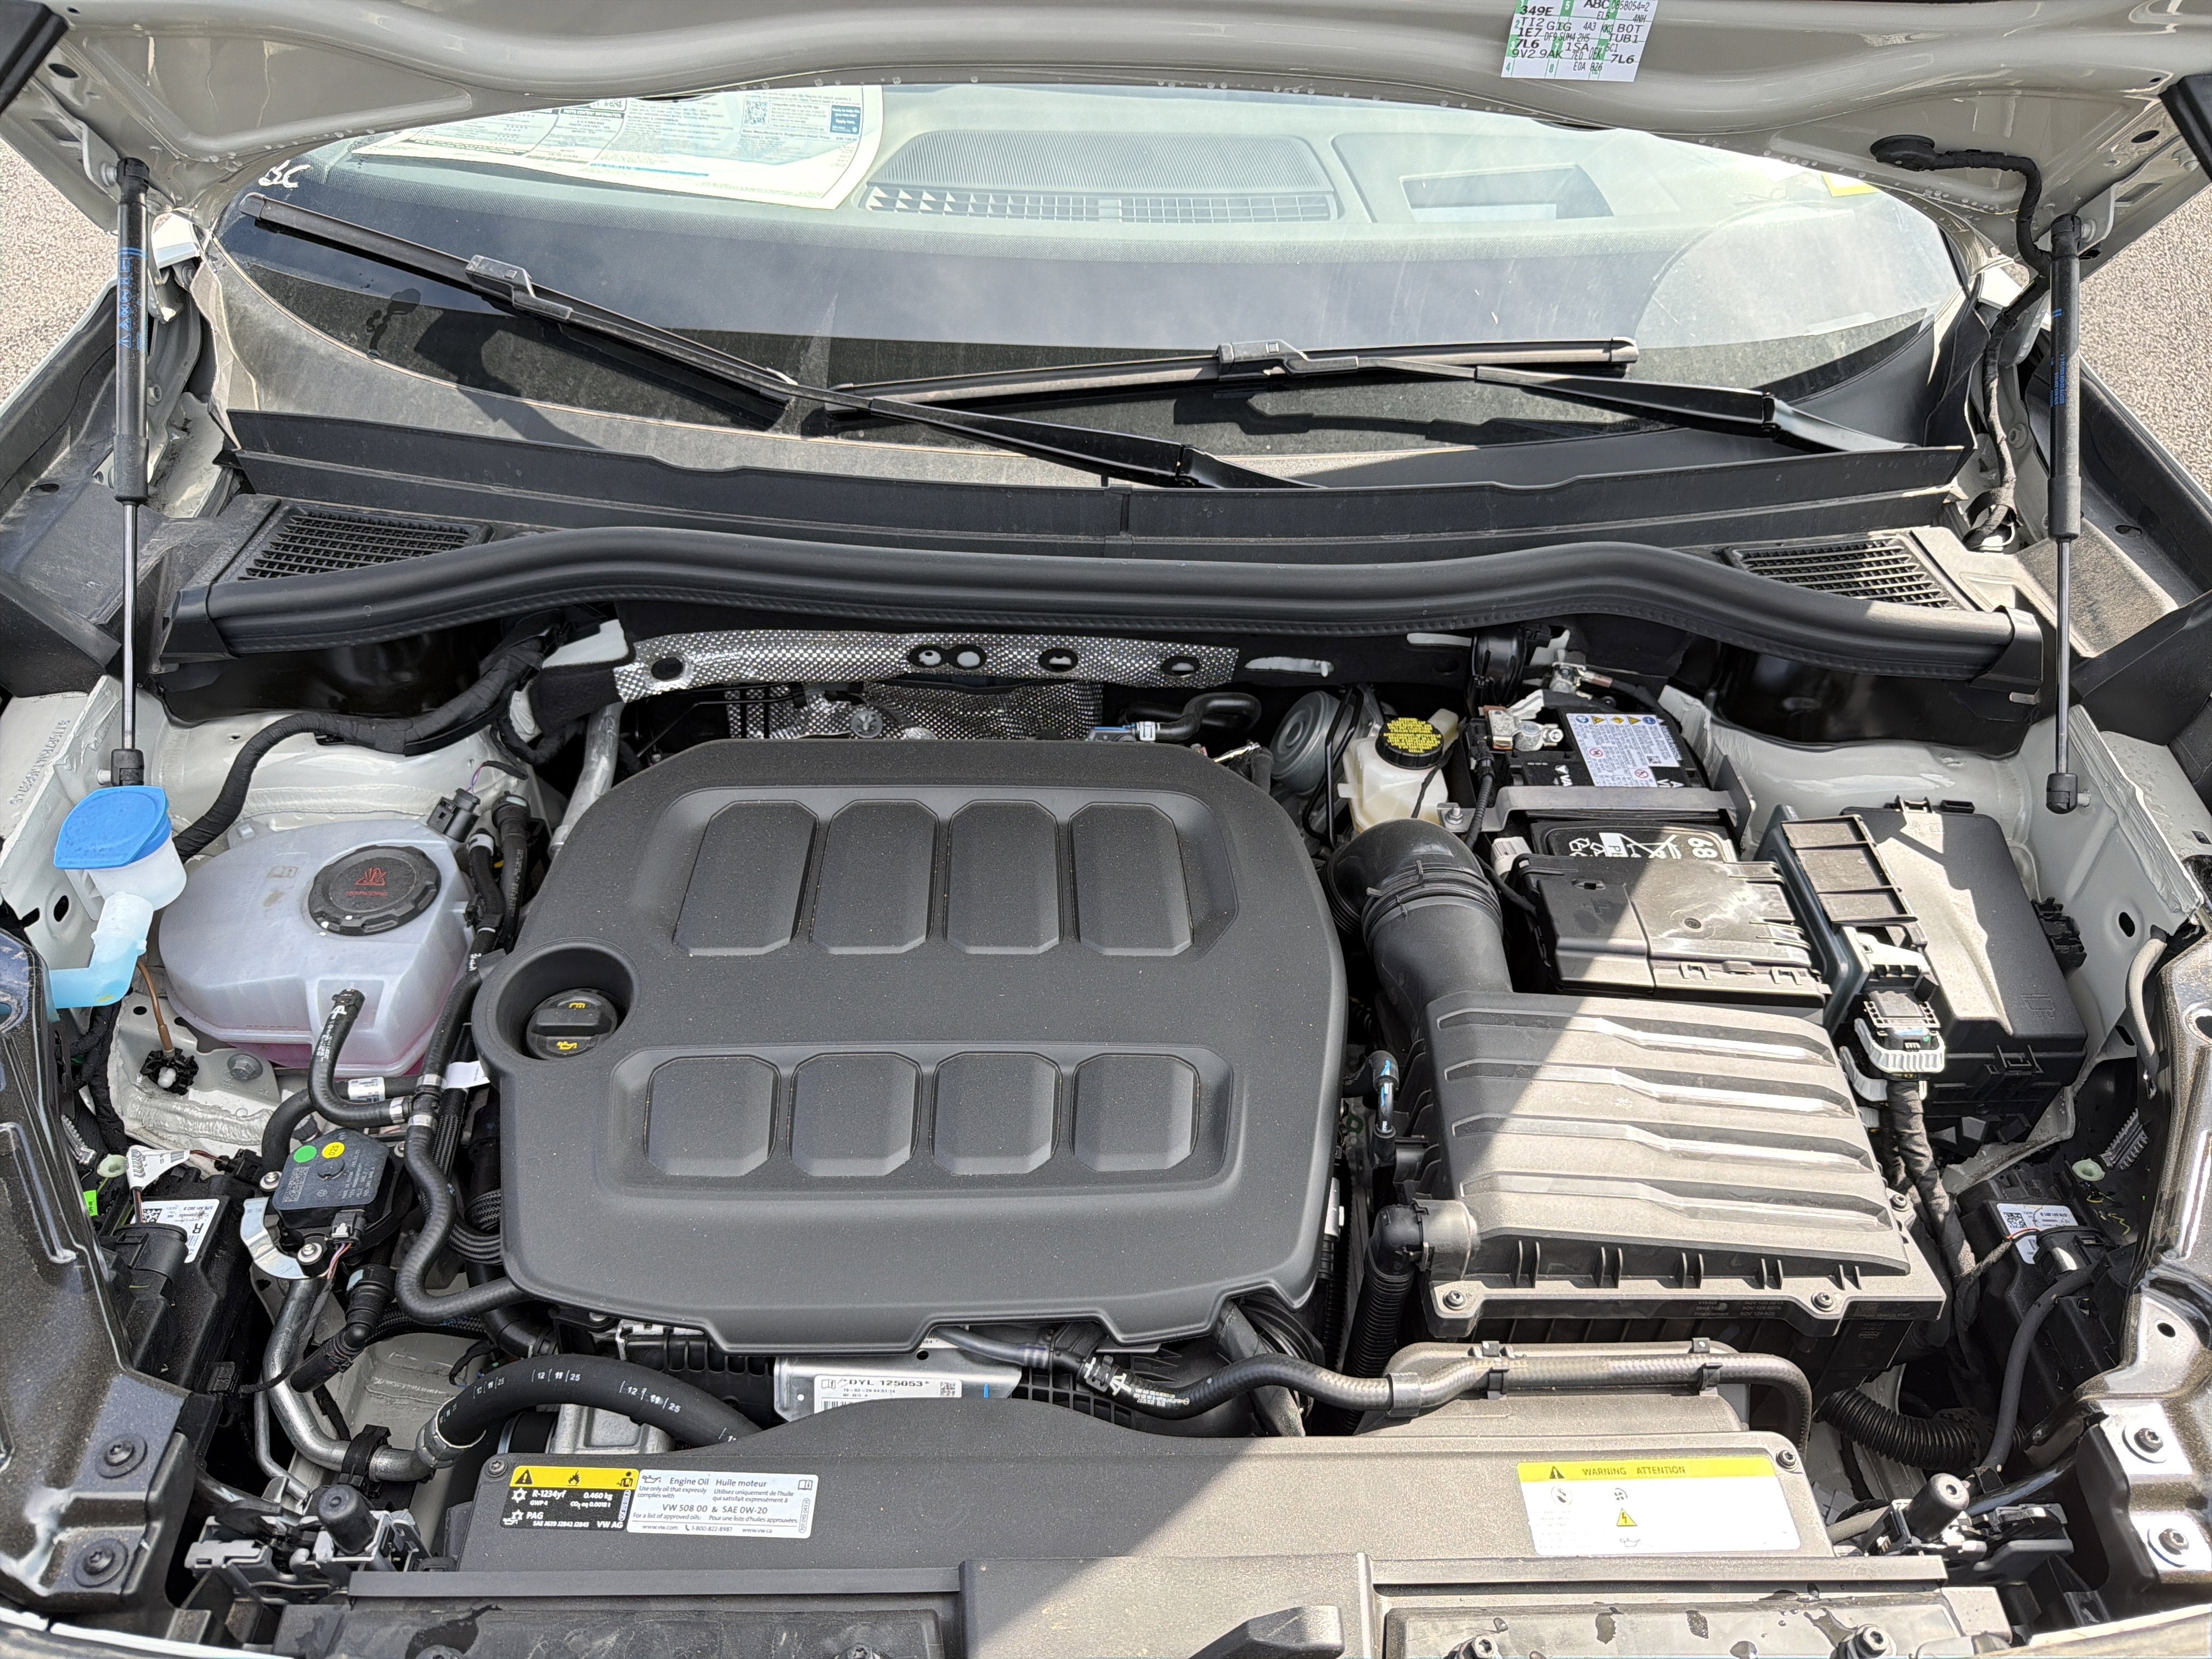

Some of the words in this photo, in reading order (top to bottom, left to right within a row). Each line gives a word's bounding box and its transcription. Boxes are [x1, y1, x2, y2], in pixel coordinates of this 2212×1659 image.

[1519, 5, 1554, 16] 349E
[1565, 1, 1571, 10] 5
[1596, 11, 1611, 20] EL5
[1633, 14, 1646, 23] 4NH
[1514, 19, 1520, 29] 2
[1547, 21, 1572, 31] GIG
[1583, 21, 1596, 31] 4A3
[1517, 27, 1543, 37] 1E7
[1544, 32, 1557, 41] DF9
[1577, 33, 1590, 42] 2H5
[1608, 33, 1639, 43] TUB1
[1515, 38, 1540, 48] 7L6
[1566, 42, 1589, 52] 1SA
[1511, 49, 1536, 58] 9V2
[1539, 49, 1563, 59] 9AK
[1611, 54, 1635, 64] 7L6
[1505, 63, 1511, 72] 4
[1549, 64, 1554, 73] 8
[192, 1223, 204, 1234] R
[570, 1373, 581, 1381] 25
[628, 1386, 637, 1396] 12
[668, 1402, 681, 1413] 25
[1582, 1467, 1627, 1476] WARNING
[1637, 1465, 1686, 1475] ATTENTION
[670, 1477, 696, 1487] Engine
[715, 1479, 736, 1487] Huile
[532, 1489, 567, 1500] R-1234yf
[604, 1492, 614, 1500] kg
[662, 1503, 678, 1511] VW
[722, 1505, 738, 1514] SAE
[740, 1506, 768, 1514] 0W-20
[526, 1511, 544, 1520] PAG
[611, 1521, 624, 1529] AG
